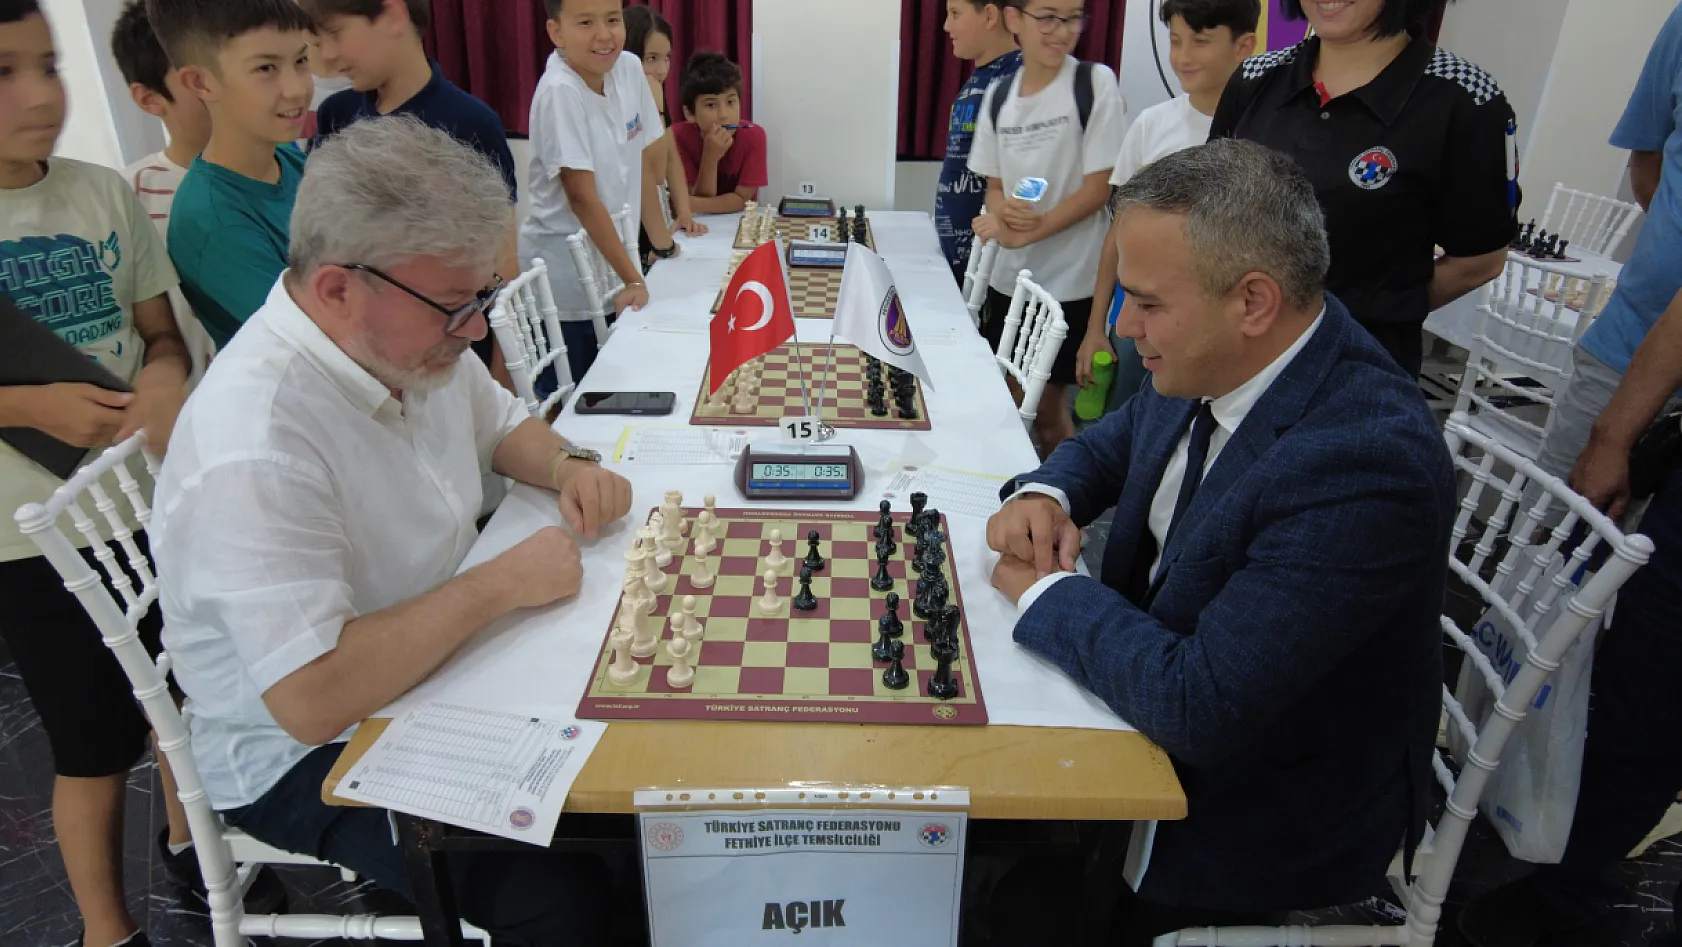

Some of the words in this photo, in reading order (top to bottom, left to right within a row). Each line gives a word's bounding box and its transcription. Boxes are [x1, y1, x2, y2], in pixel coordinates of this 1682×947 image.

[802, 184, 813, 194] 13
[813, 228, 828, 239] 14
[65, 315, 121, 346] OADING
[787, 421, 812, 439] 15
[705, 704, 746, 712] TÜRKİYE
[747, 705, 790, 713] SATRANÇ
[704, 819, 755, 833] TÜRKİYE
[757, 819, 814, 832] SATRANÇ
[817, 820, 901, 832] FEDERASYONU
[724, 834, 772, 849] FETHİYE
[774, 832, 799, 848] İLÇE
[802, 833, 881, 846] TEMSİLCİLİĞİ
[762, 899, 846, 934] AÇIK
